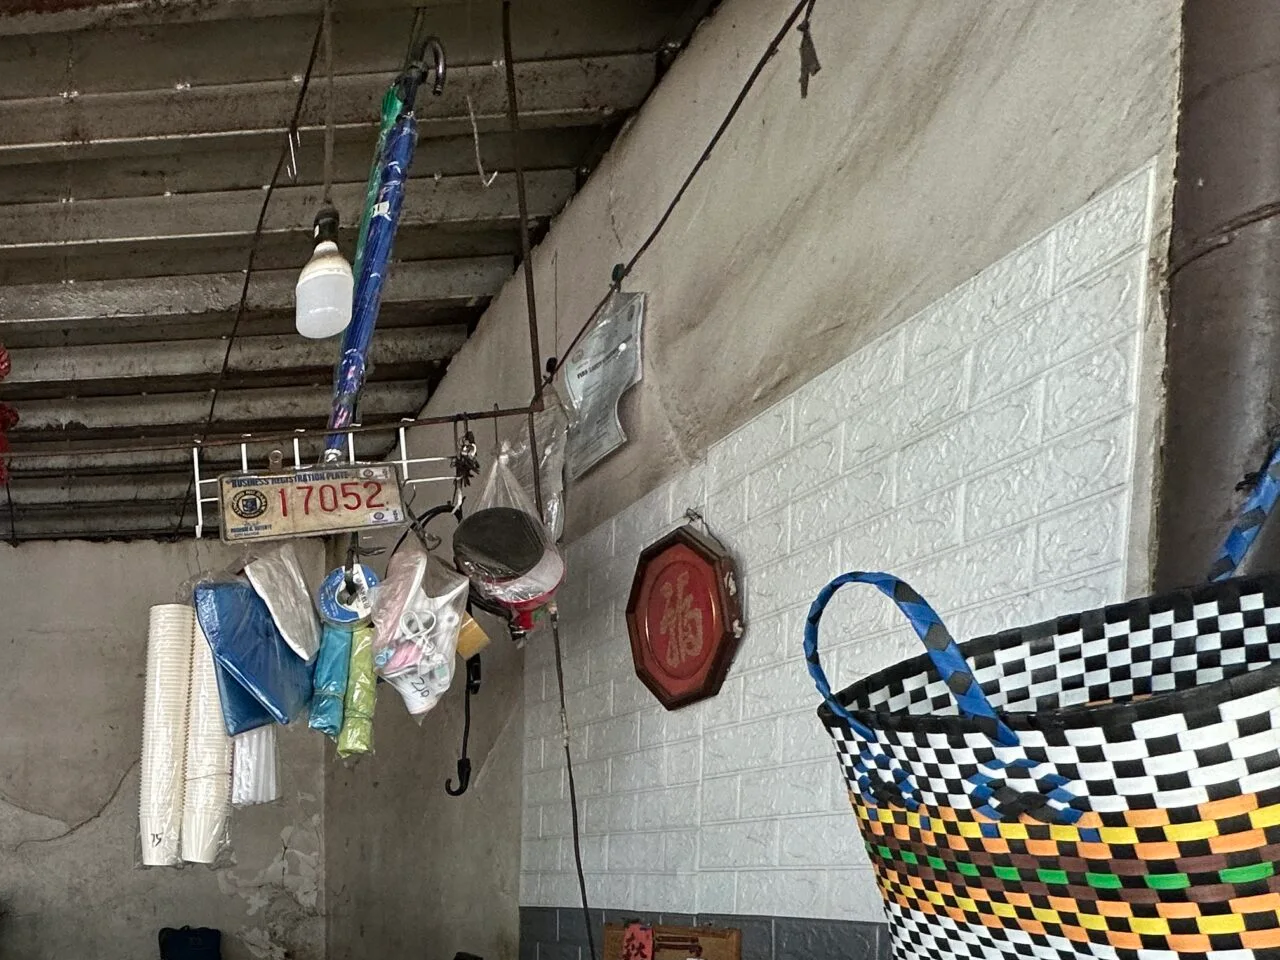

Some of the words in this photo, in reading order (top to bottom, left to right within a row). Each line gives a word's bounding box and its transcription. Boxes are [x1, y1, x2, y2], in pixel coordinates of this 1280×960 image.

[230, 477, 269, 488] BUSINESS
[271, 471, 325, 485] REGISTRATION
[326, 471, 349, 480] PLATE
[278, 481, 385, 516] 17052
